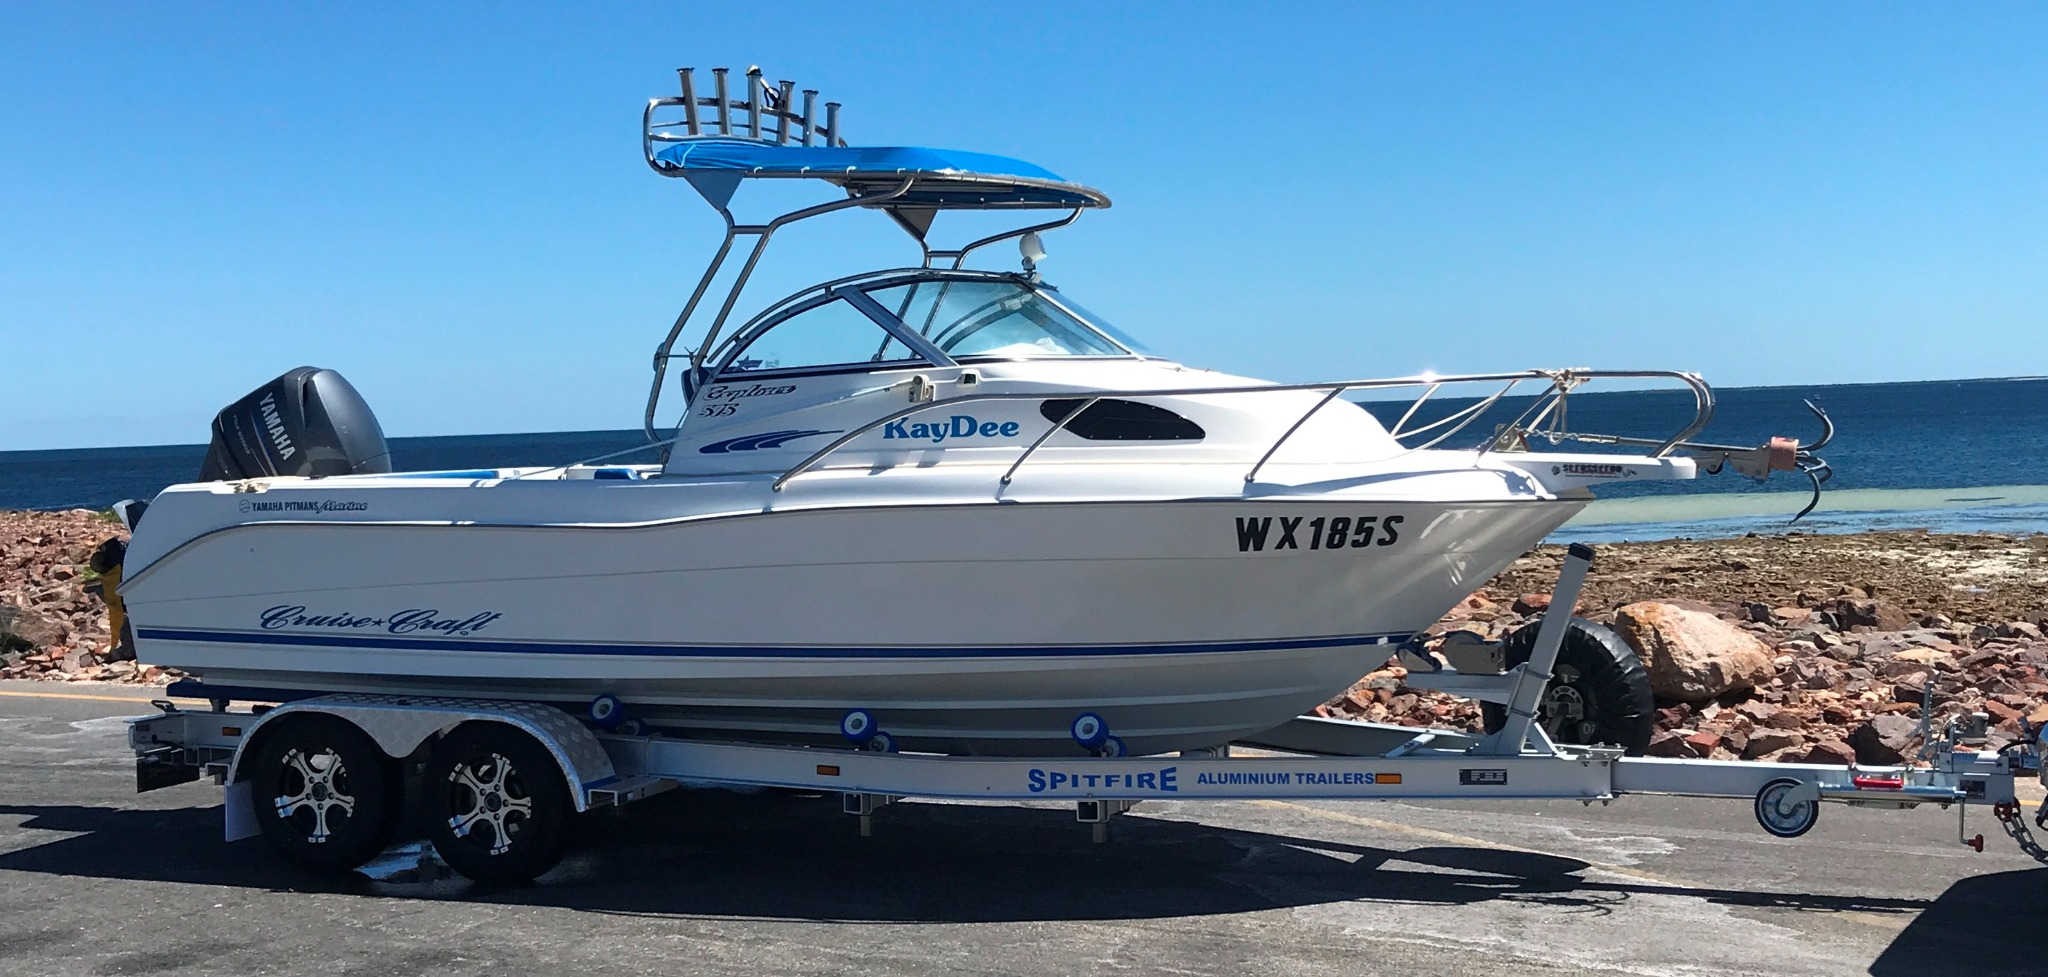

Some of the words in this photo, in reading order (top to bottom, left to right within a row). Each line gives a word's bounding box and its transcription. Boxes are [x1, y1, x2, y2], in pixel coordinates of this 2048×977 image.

[697, 403, 740, 418] 575
[260, 391, 296, 461] YAMAHA
[883, 415, 1020, 443] KayDee
[251, 501, 283, 512] YAMAHA
[284, 501, 319, 512] PITMANS
[1235, 515, 1404, 552] WX185S
[260, 605, 372, 630] Cruise
[387, 608, 503, 636] Craft
[1028, 766, 1178, 793] SPITFIRE
[1197, 772, 1290, 785] ALUMINIUM
[1295, 772, 1375, 785] TRAILERS
